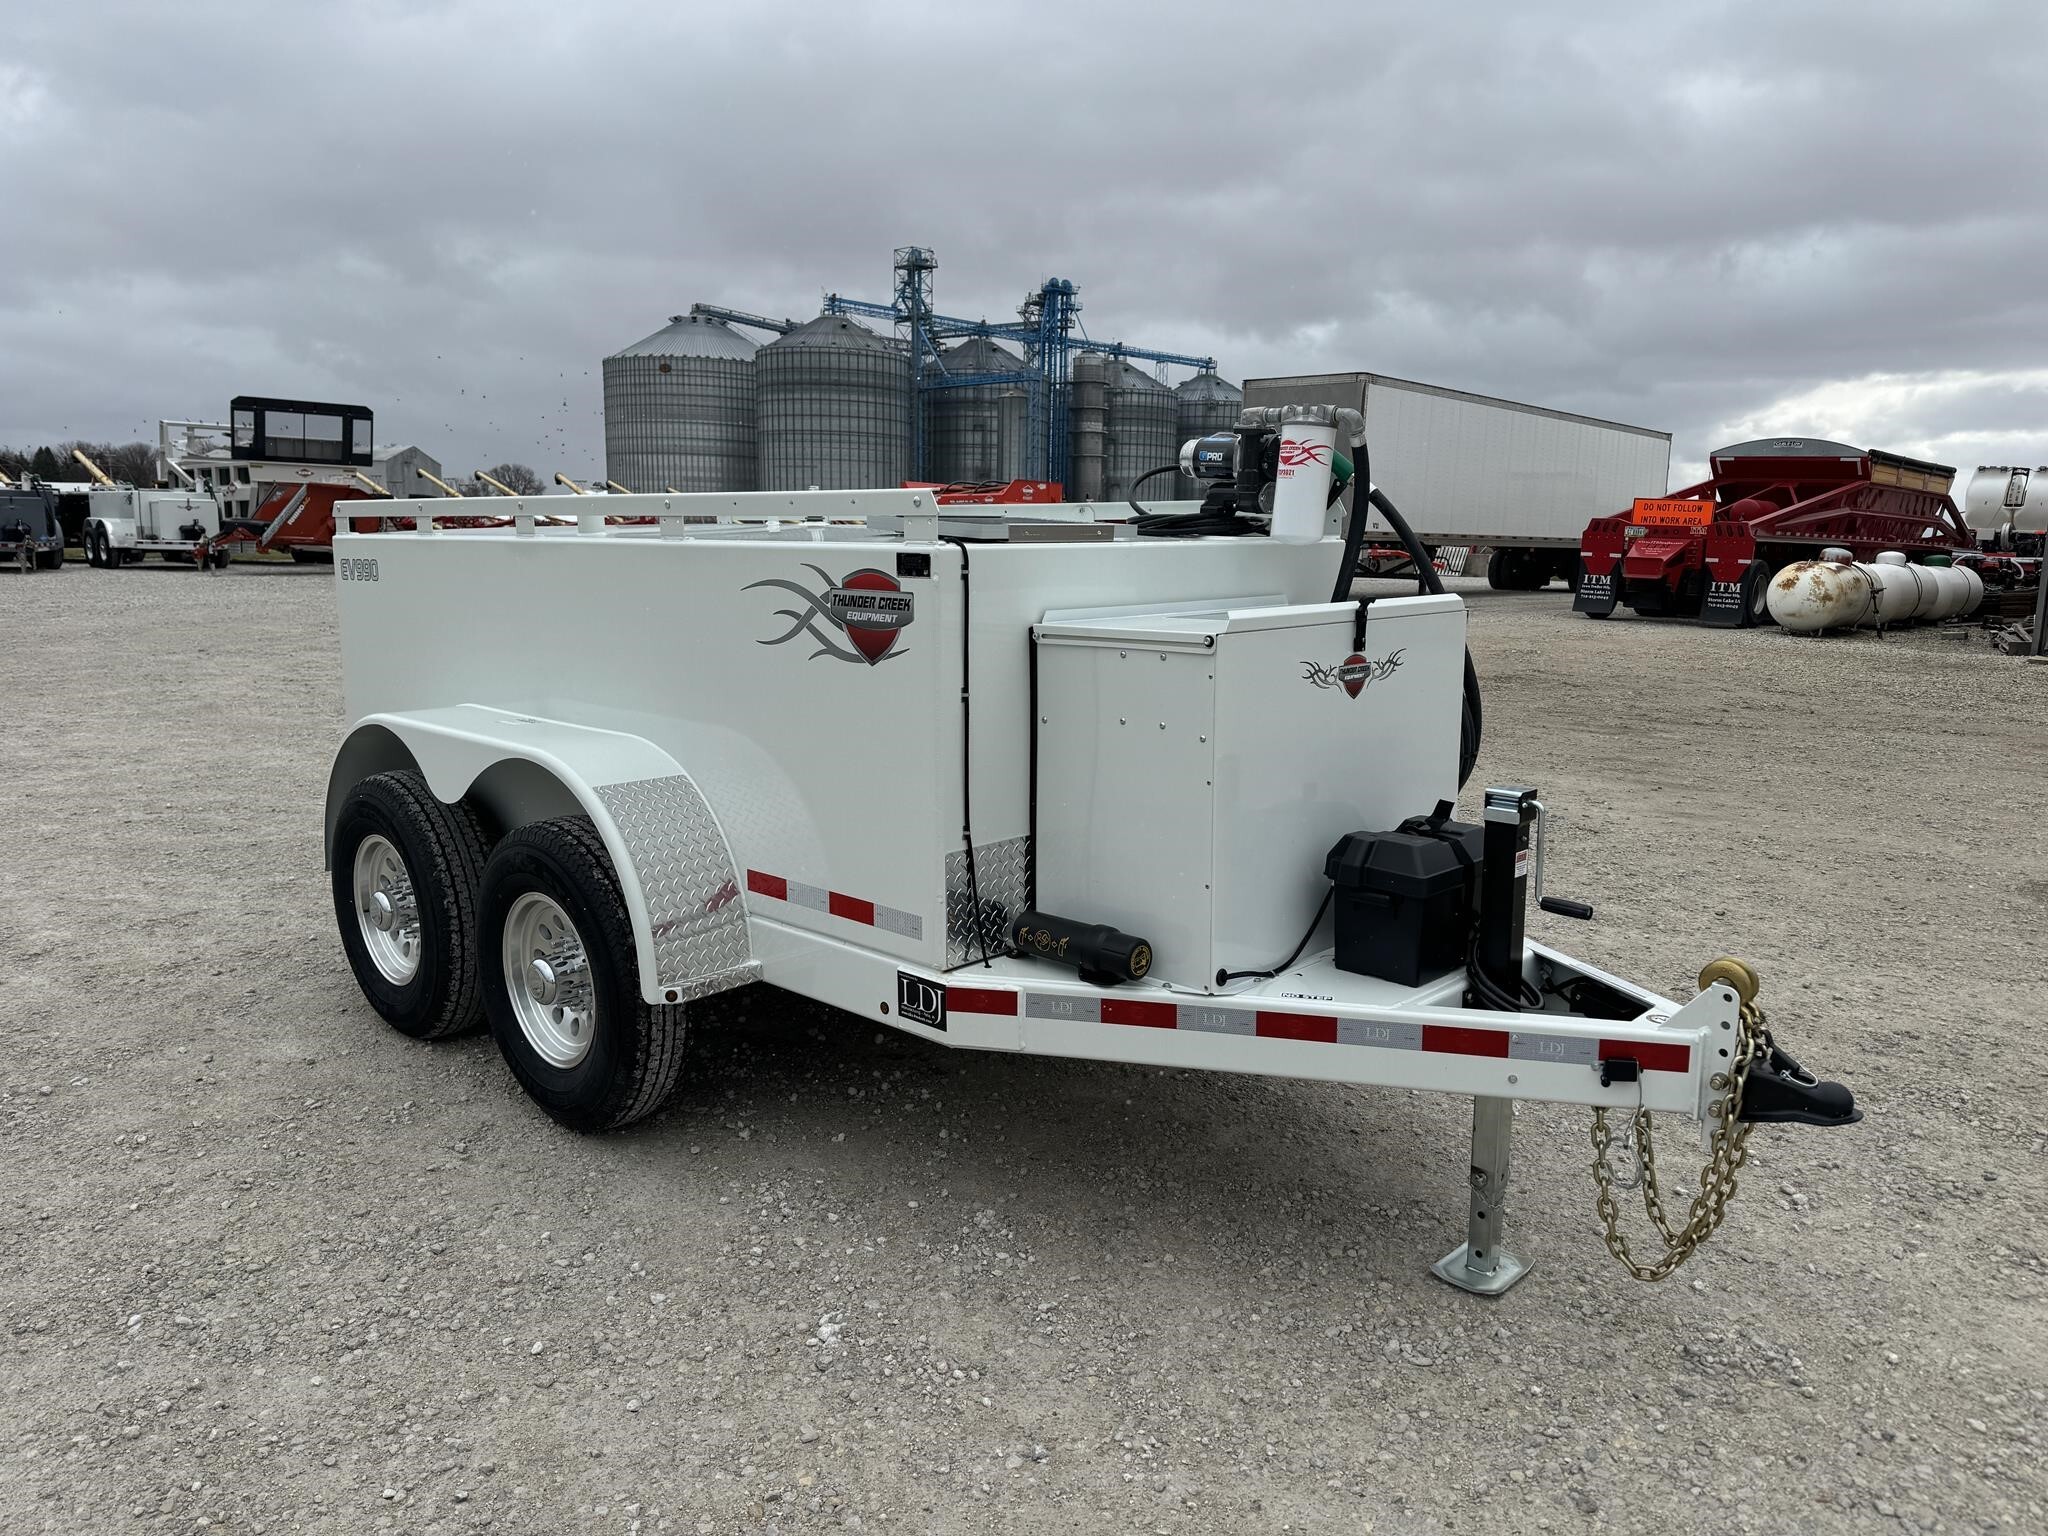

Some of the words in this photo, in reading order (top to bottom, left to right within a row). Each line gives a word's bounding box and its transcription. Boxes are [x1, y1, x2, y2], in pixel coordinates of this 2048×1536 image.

[1643, 503, 1654, 511] DO
[1656, 503, 1671, 512] NOT
[1673, 504, 1704, 513] FOLLOW
[1640, 515, 1657, 523] INTO
[1660, 516, 1681, 525] WORK
[1682, 517, 1703, 526] AREA
[340, 558, 379, 582] EV990
[1583, 574, 1612, 585] ITM
[1710, 581, 1743, 593] ITM
[832, 594, 877, 609] THUNDER
[878, 597, 912, 612] CREEK
[846, 611, 898, 623] EQUIPMENT
[901, 977, 945, 1025] LDJ
[1052, 1001, 1073, 1014] LDJ
[1203, 1013, 1226, 1027] LDJ
[1367, 1027, 1392, 1041] LDJ
[1540, 1042, 1565, 1056] LDJ
